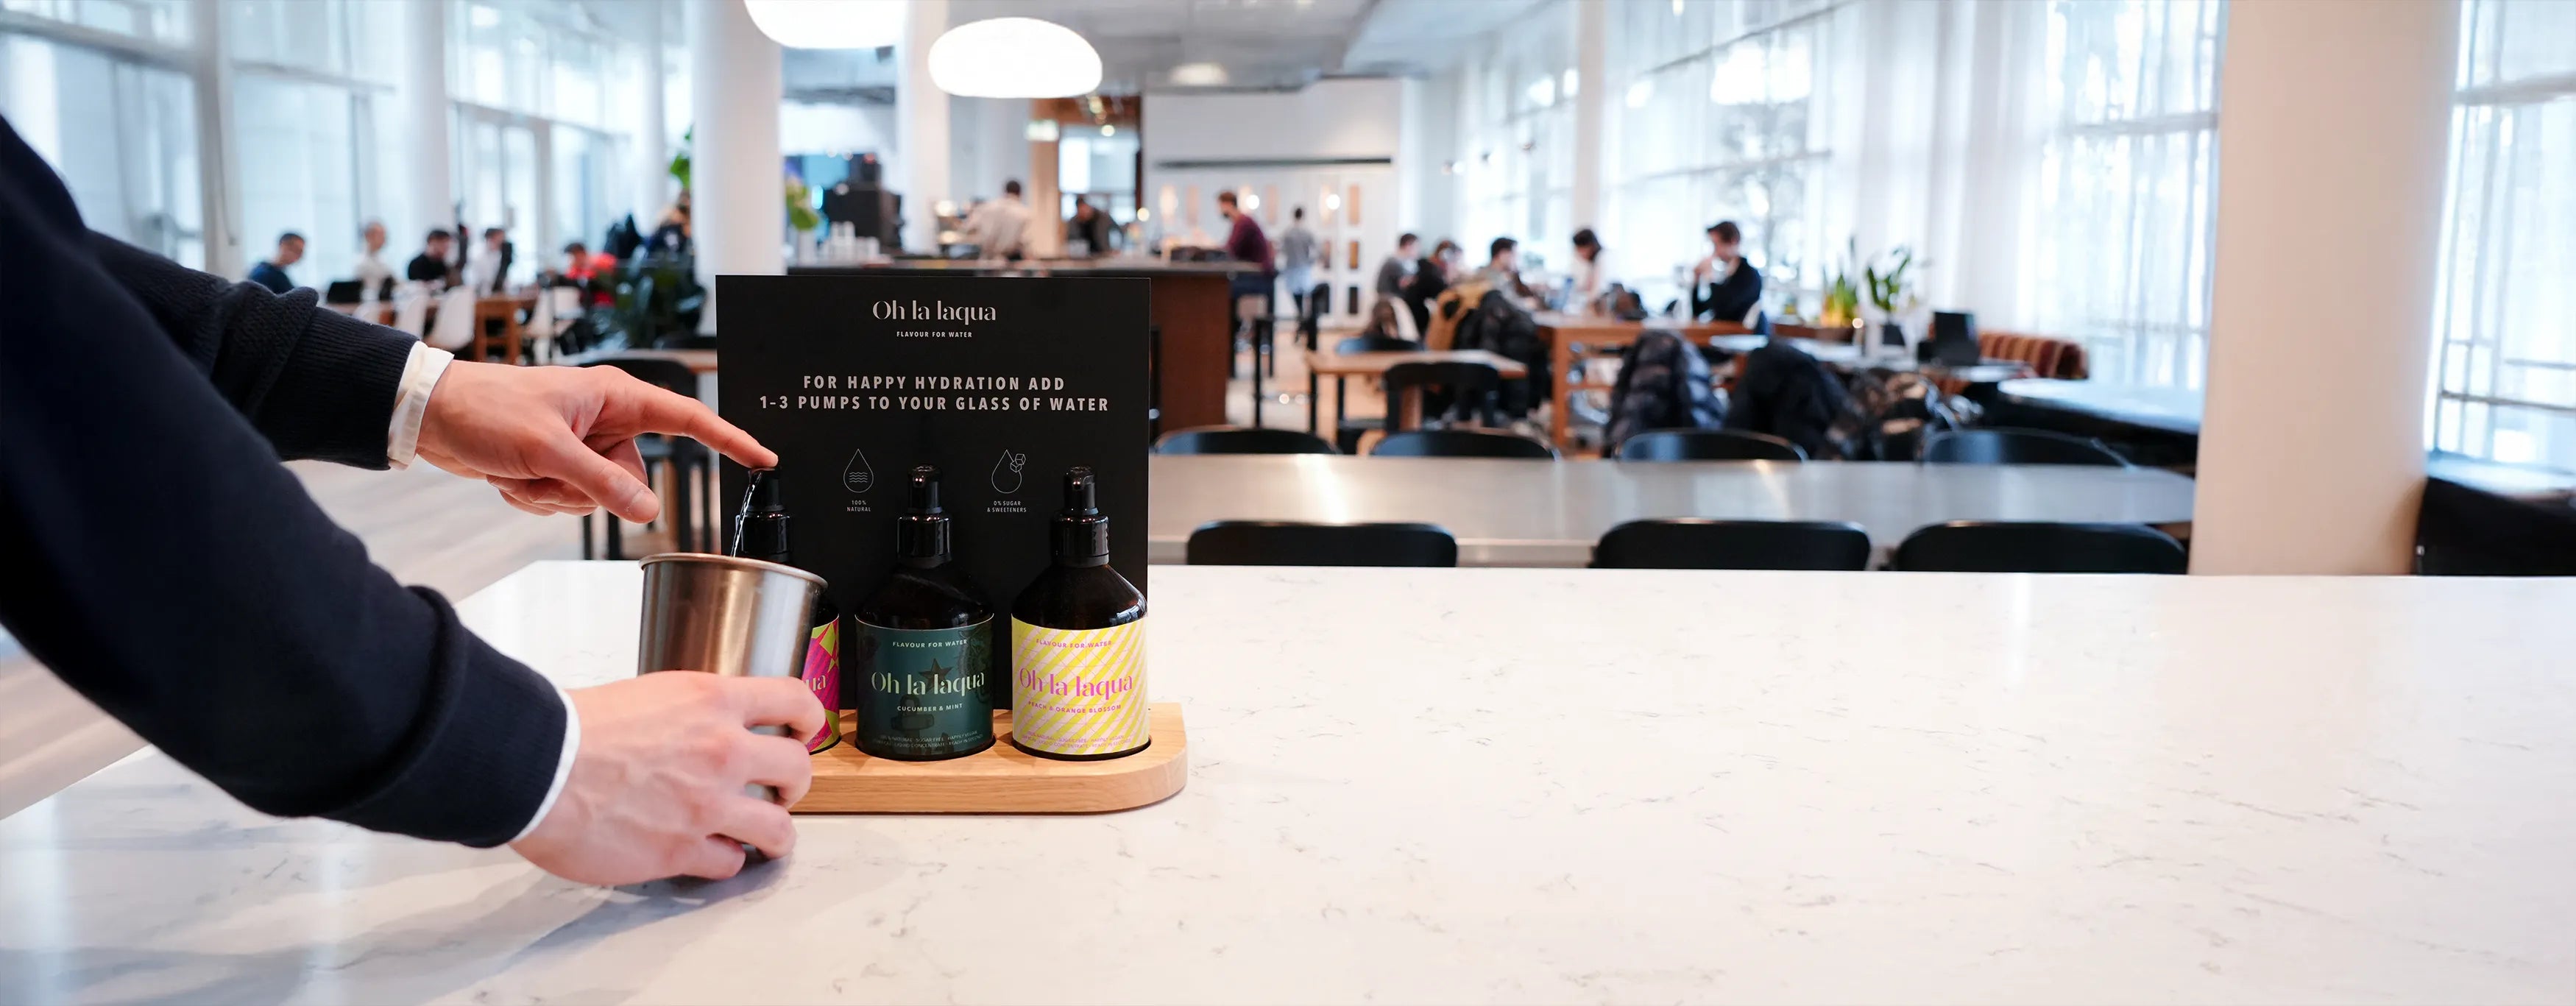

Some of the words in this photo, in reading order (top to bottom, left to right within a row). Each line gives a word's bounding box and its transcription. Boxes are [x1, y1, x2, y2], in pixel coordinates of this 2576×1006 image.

[872, 300, 905, 320] Oh
[912, 300, 930, 320] la
[937, 300, 996, 325] laqua
[804, 375, 837, 389] FOR
[848, 376, 906, 389] HAPPY
[915, 376, 1019, 390] HYDRATION
[1028, 377, 1064, 390] ADD
[798, 396, 860, 409] PUMPS
[868, 397, 890, 410] TO
[899, 397, 946, 410] YOUR
[955, 397, 1010, 411] GLASS
[1019, 397, 1041, 411] OF
[1050, 398, 1108, 411] WATER
[945, 639, 968, 647] WATER
[1036, 638, 1068, 648] FLAVOUR
[1088, 640, 1112, 648] WATER
[871, 671, 899, 694] Oh
[907, 673, 926, 695] la
[933, 672, 985, 697] laqua
[1019, 667, 1043, 692] Oh
[1050, 673, 1068, 696] la
[1076, 675, 1133, 701] laqua
[946, 703, 963, 711] MINT
[1027, 701, 1047, 710] PEACH
[1089, 704, 1122, 713] BLOSSOM
